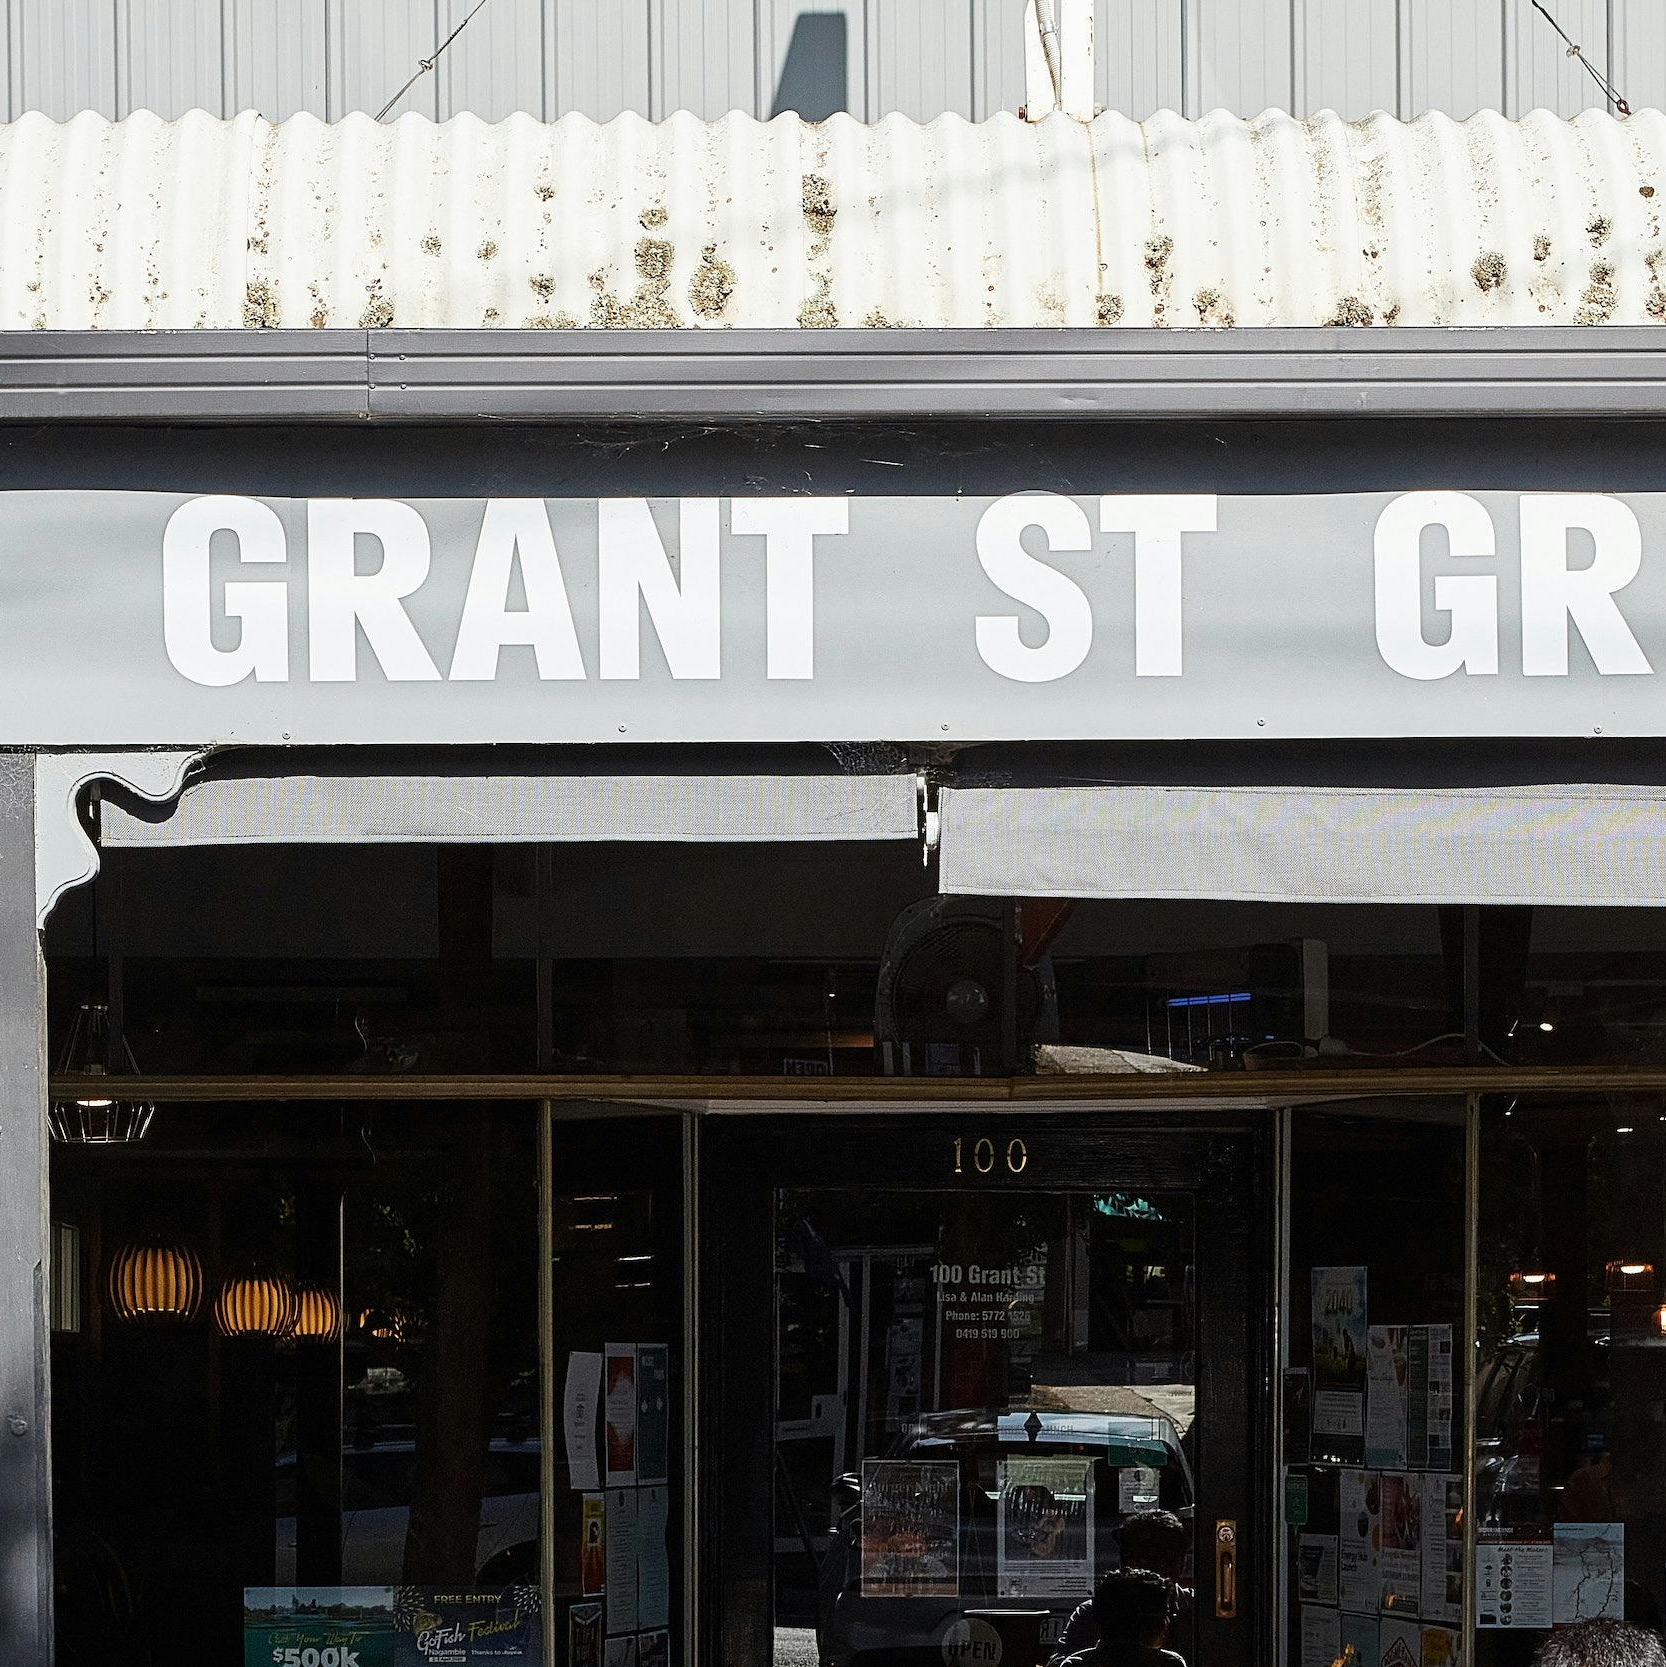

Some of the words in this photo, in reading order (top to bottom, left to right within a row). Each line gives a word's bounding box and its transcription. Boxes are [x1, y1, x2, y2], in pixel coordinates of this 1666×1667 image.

[159, 495, 847, 685] GRANT
[975, 490, 1218, 684] ST
[953, 1137, 1027, 1173] 100
[929, 1264, 963, 1284] 100
[968, 1264, 1021, 1285] Grant
[945, 1311, 980, 1321] Phone:
[434, 1594, 463, 1604] FREE
[465, 1594, 502, 1604] ENTRY
[416, 1622, 467, 1656] GoFish
